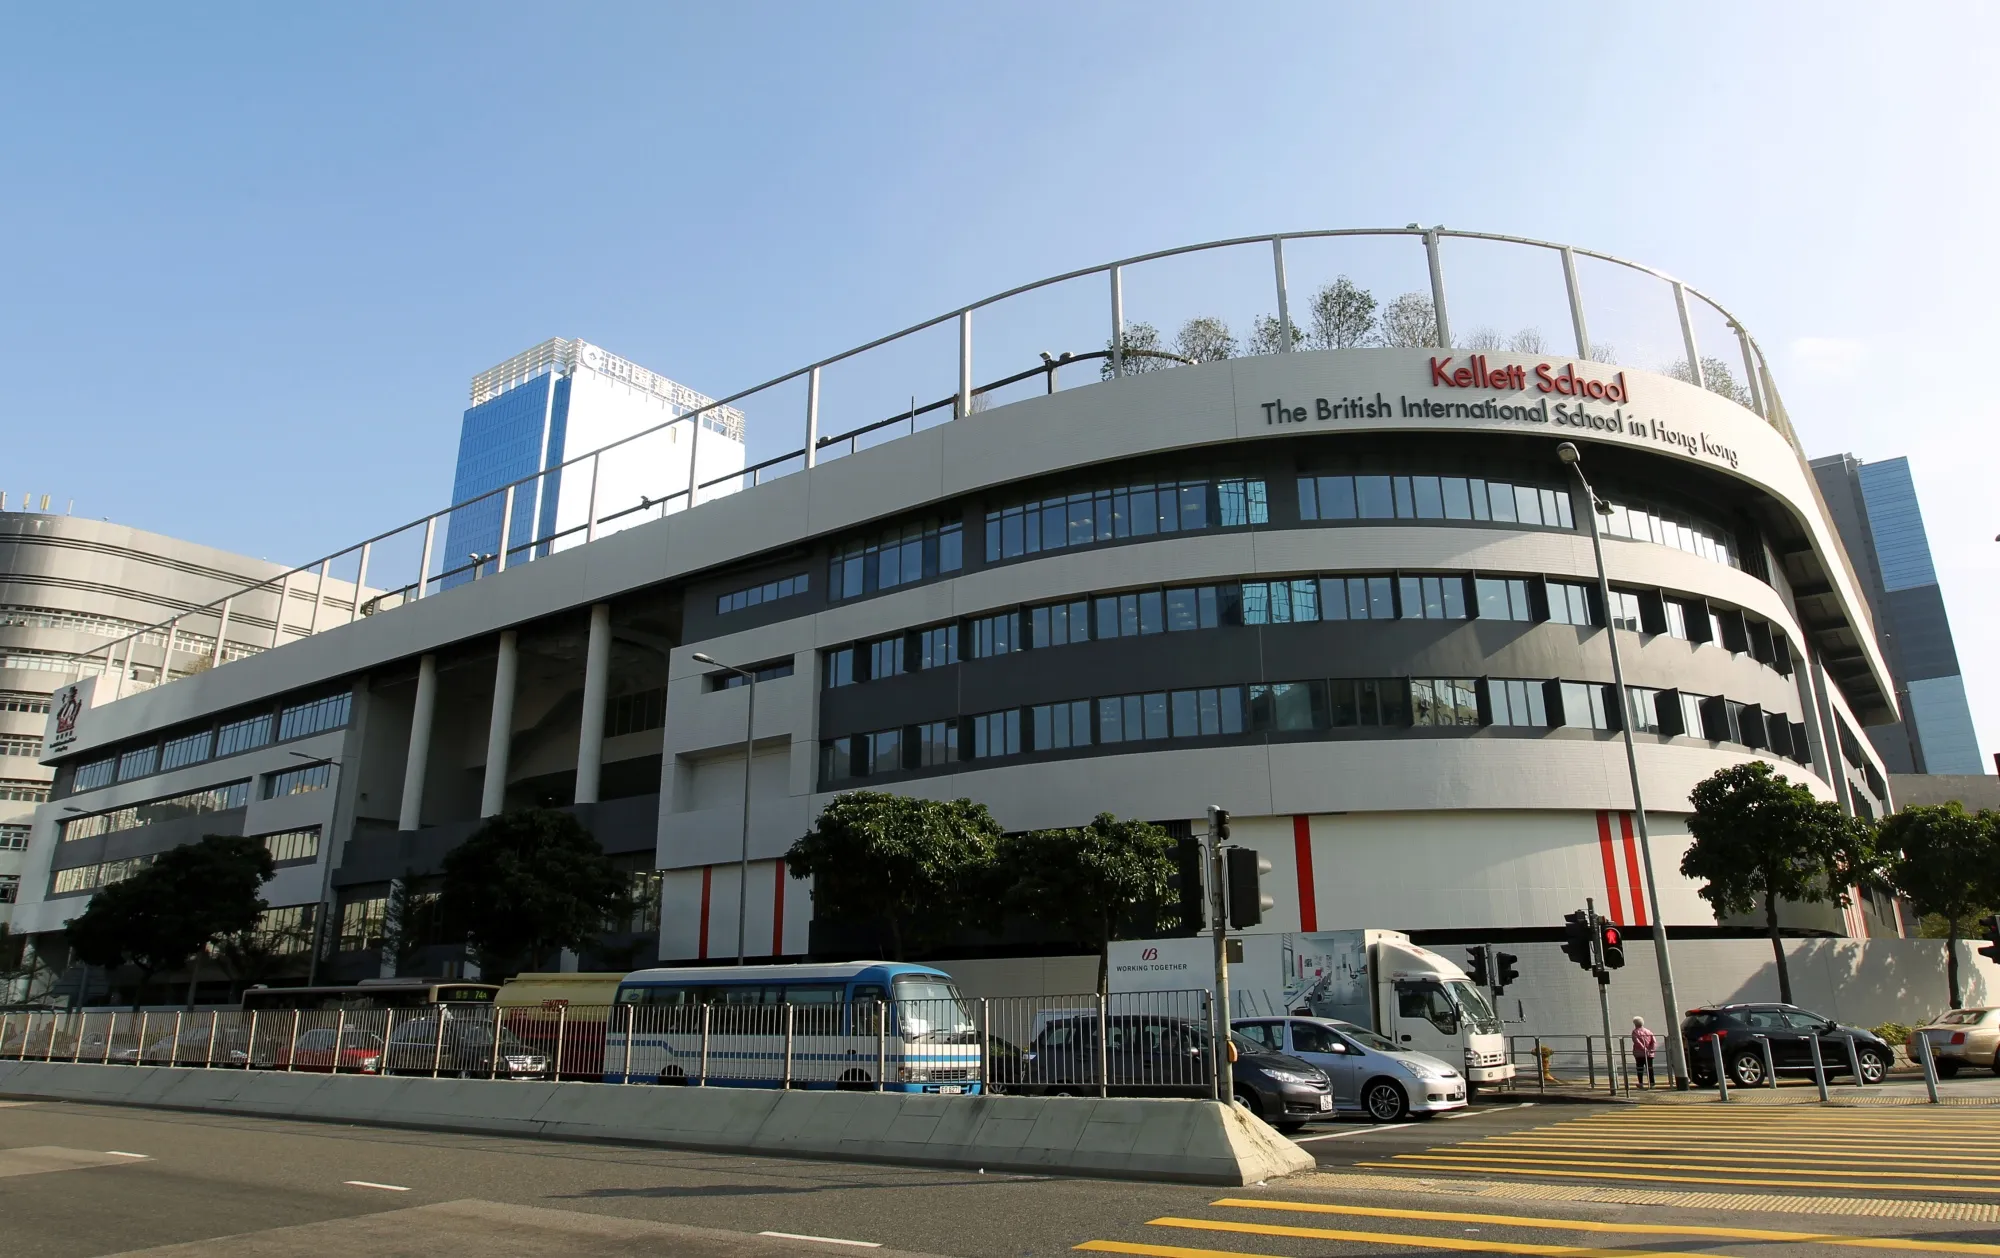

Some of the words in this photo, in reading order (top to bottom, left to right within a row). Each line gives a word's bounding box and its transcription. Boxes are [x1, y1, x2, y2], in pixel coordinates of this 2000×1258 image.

[1430, 354, 1526, 390] Kellett
[1535, 362, 1629, 403] School
[1261, 399, 1307, 425] The
[1316, 392, 1392, 421] British
[1401, 395, 1549, 422] International
[1555, 402, 1624, 432] School
[1627, 414, 1648, 437] in
[1651, 418, 1698, 455] Hong
[1700, 432, 1739, 468] Kong
[1116, 964, 1148, 972] WORKING
[1150, 963, 1188, 972] TOGETHER
